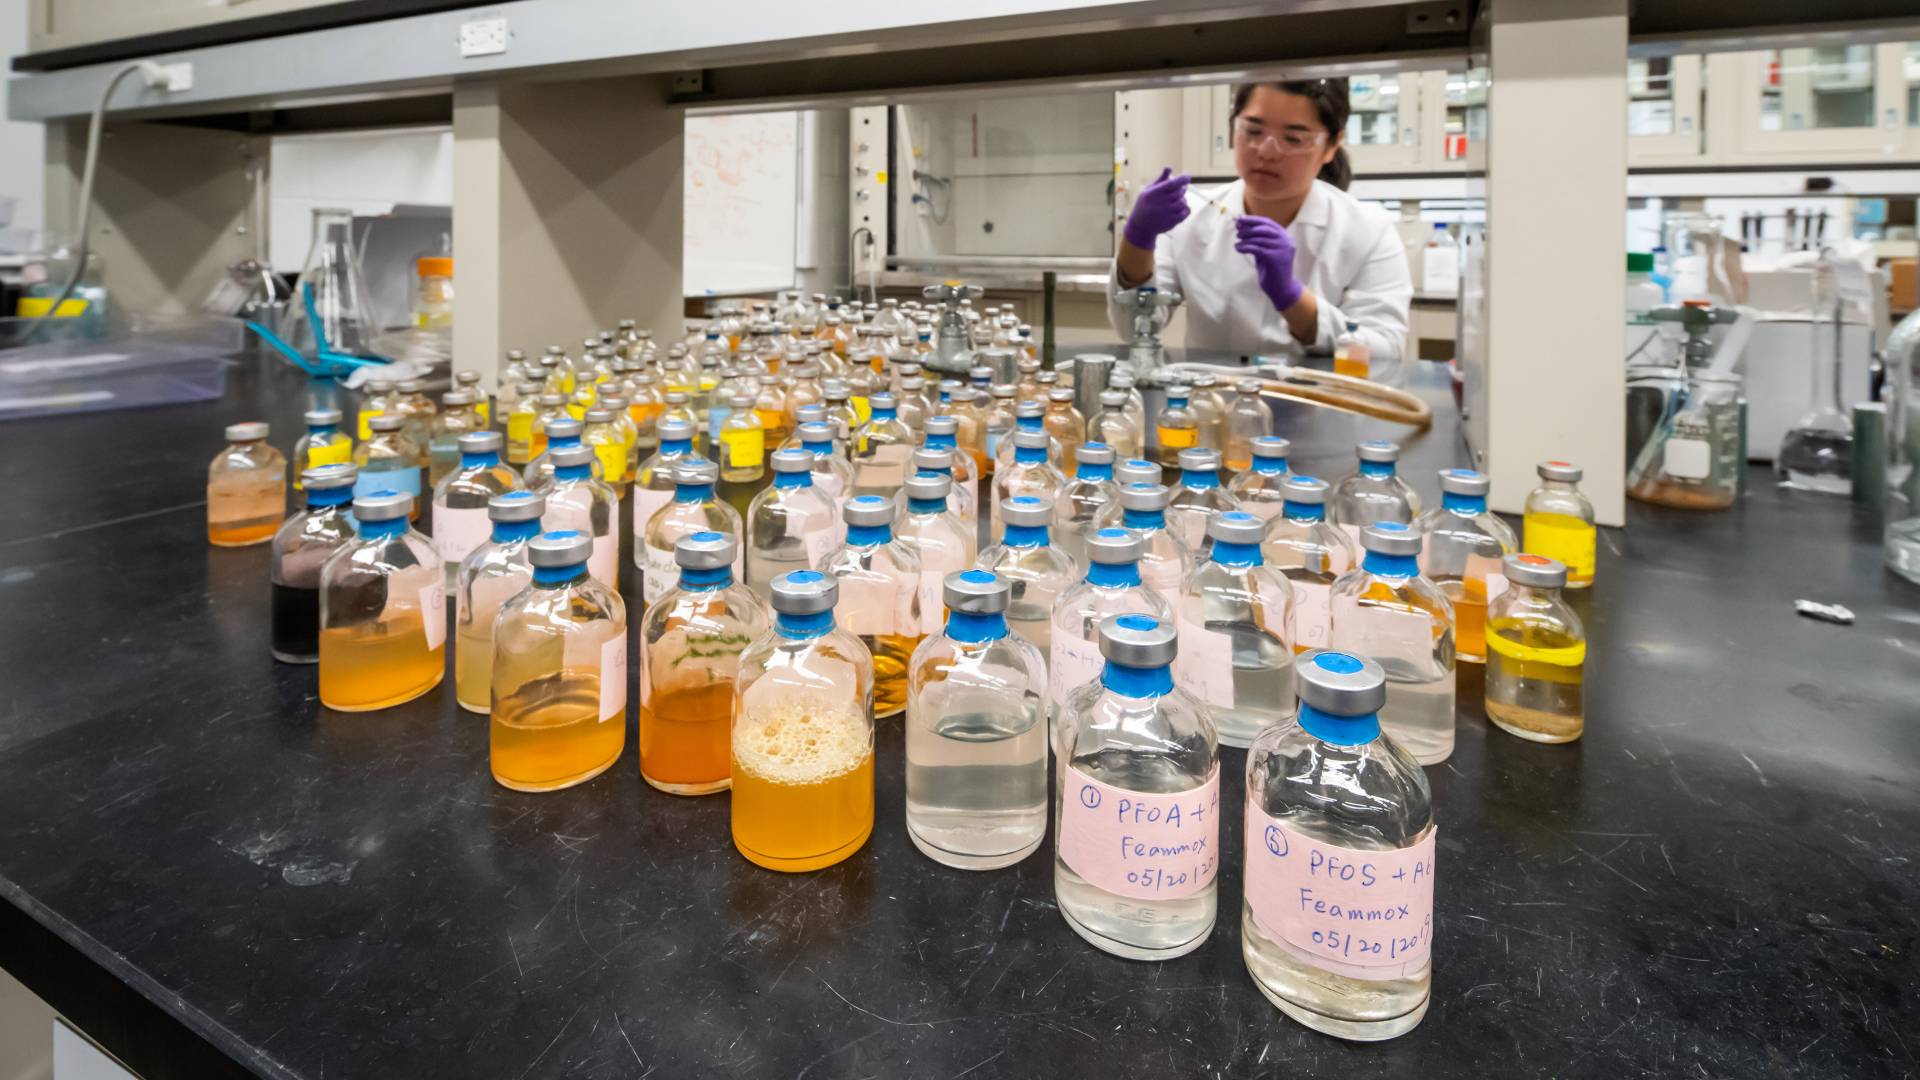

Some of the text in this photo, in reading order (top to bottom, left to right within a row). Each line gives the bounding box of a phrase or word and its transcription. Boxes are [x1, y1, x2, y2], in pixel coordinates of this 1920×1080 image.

[1118, 798, 1181, 828] PFOA
[1121, 835, 1207, 859] Feammox
[1310, 849, 1377, 887] PFOS
[1299, 888, 1409, 920] Feammox
